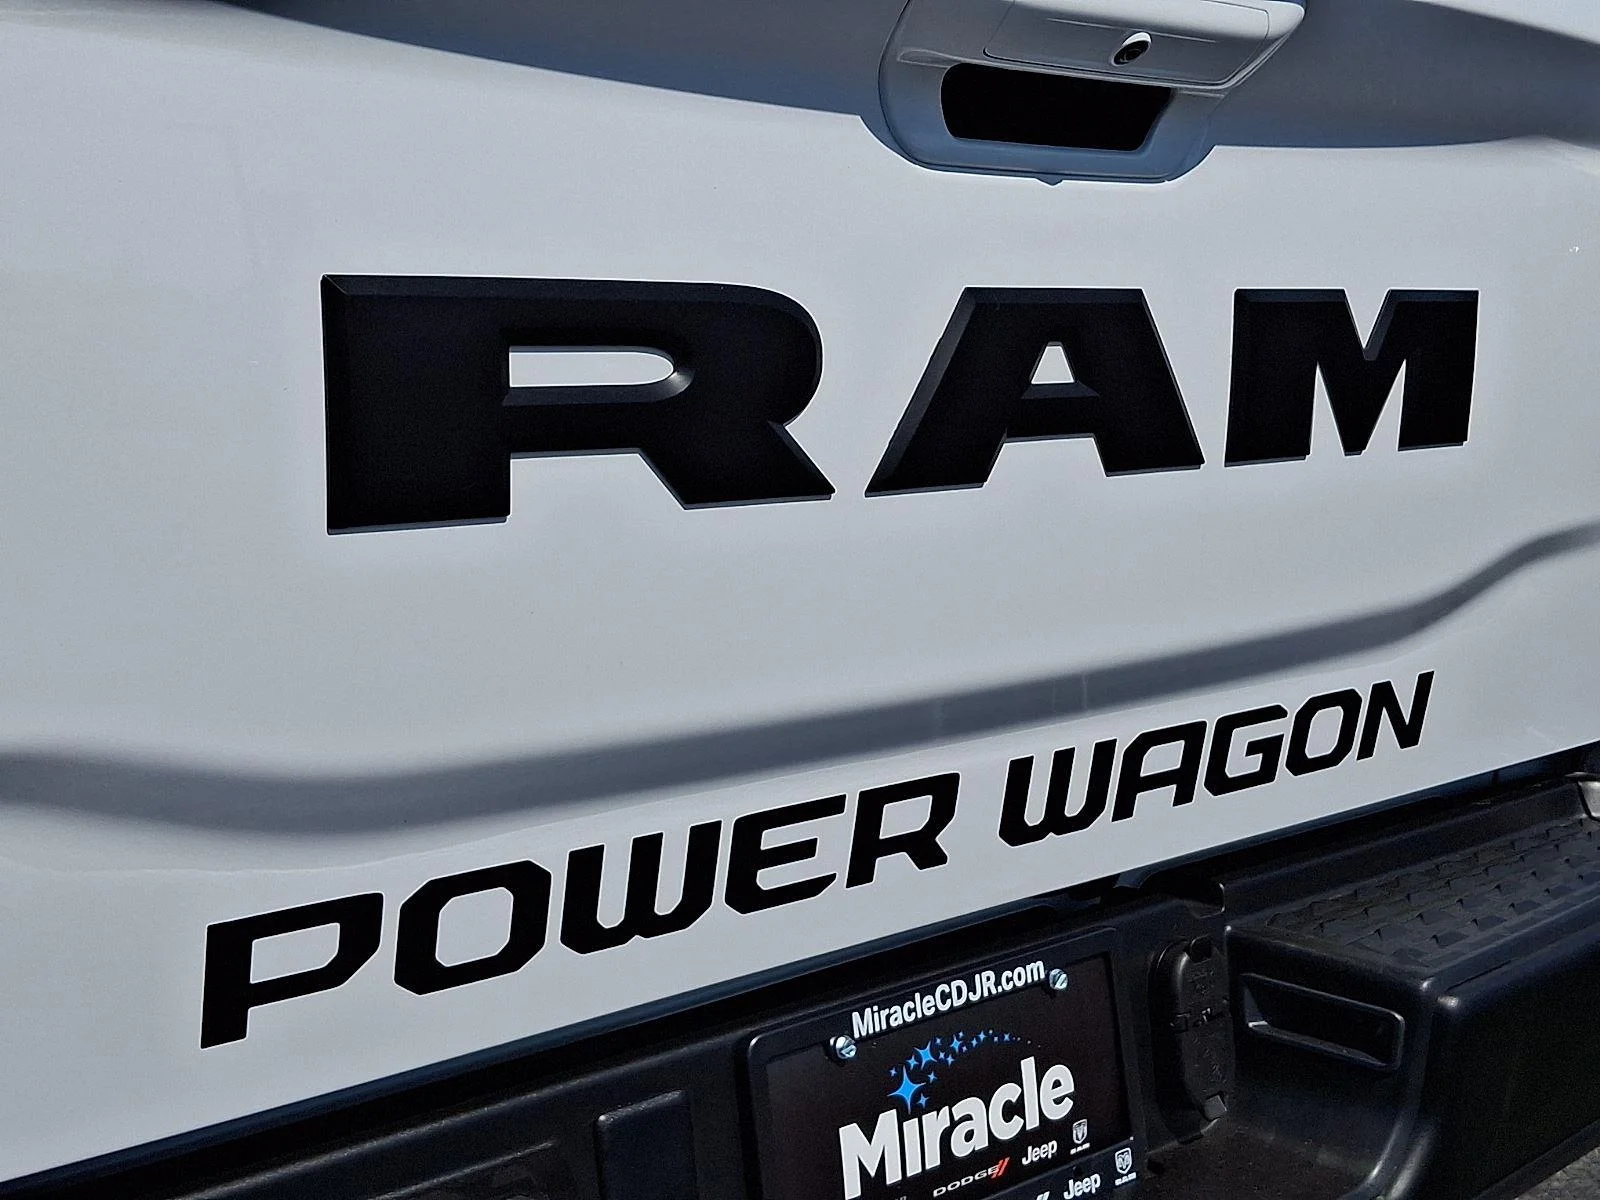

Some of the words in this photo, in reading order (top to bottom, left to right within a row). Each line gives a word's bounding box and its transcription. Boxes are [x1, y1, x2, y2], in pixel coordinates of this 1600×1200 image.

[320, 273, 1480, 536] RAM
[200, 772, 961, 1050] POWER
[998, 670, 1435, 847] WAGON
[851, 959, 1046, 1040] MiracleCDJR.com
[838, 1055, 1075, 1200] Miracle
[932, 1164, 1001, 1198] DODGE
[1021, 1140, 1058, 1166] Jeep
[1063, 1173, 1101, 1200] Jeep
